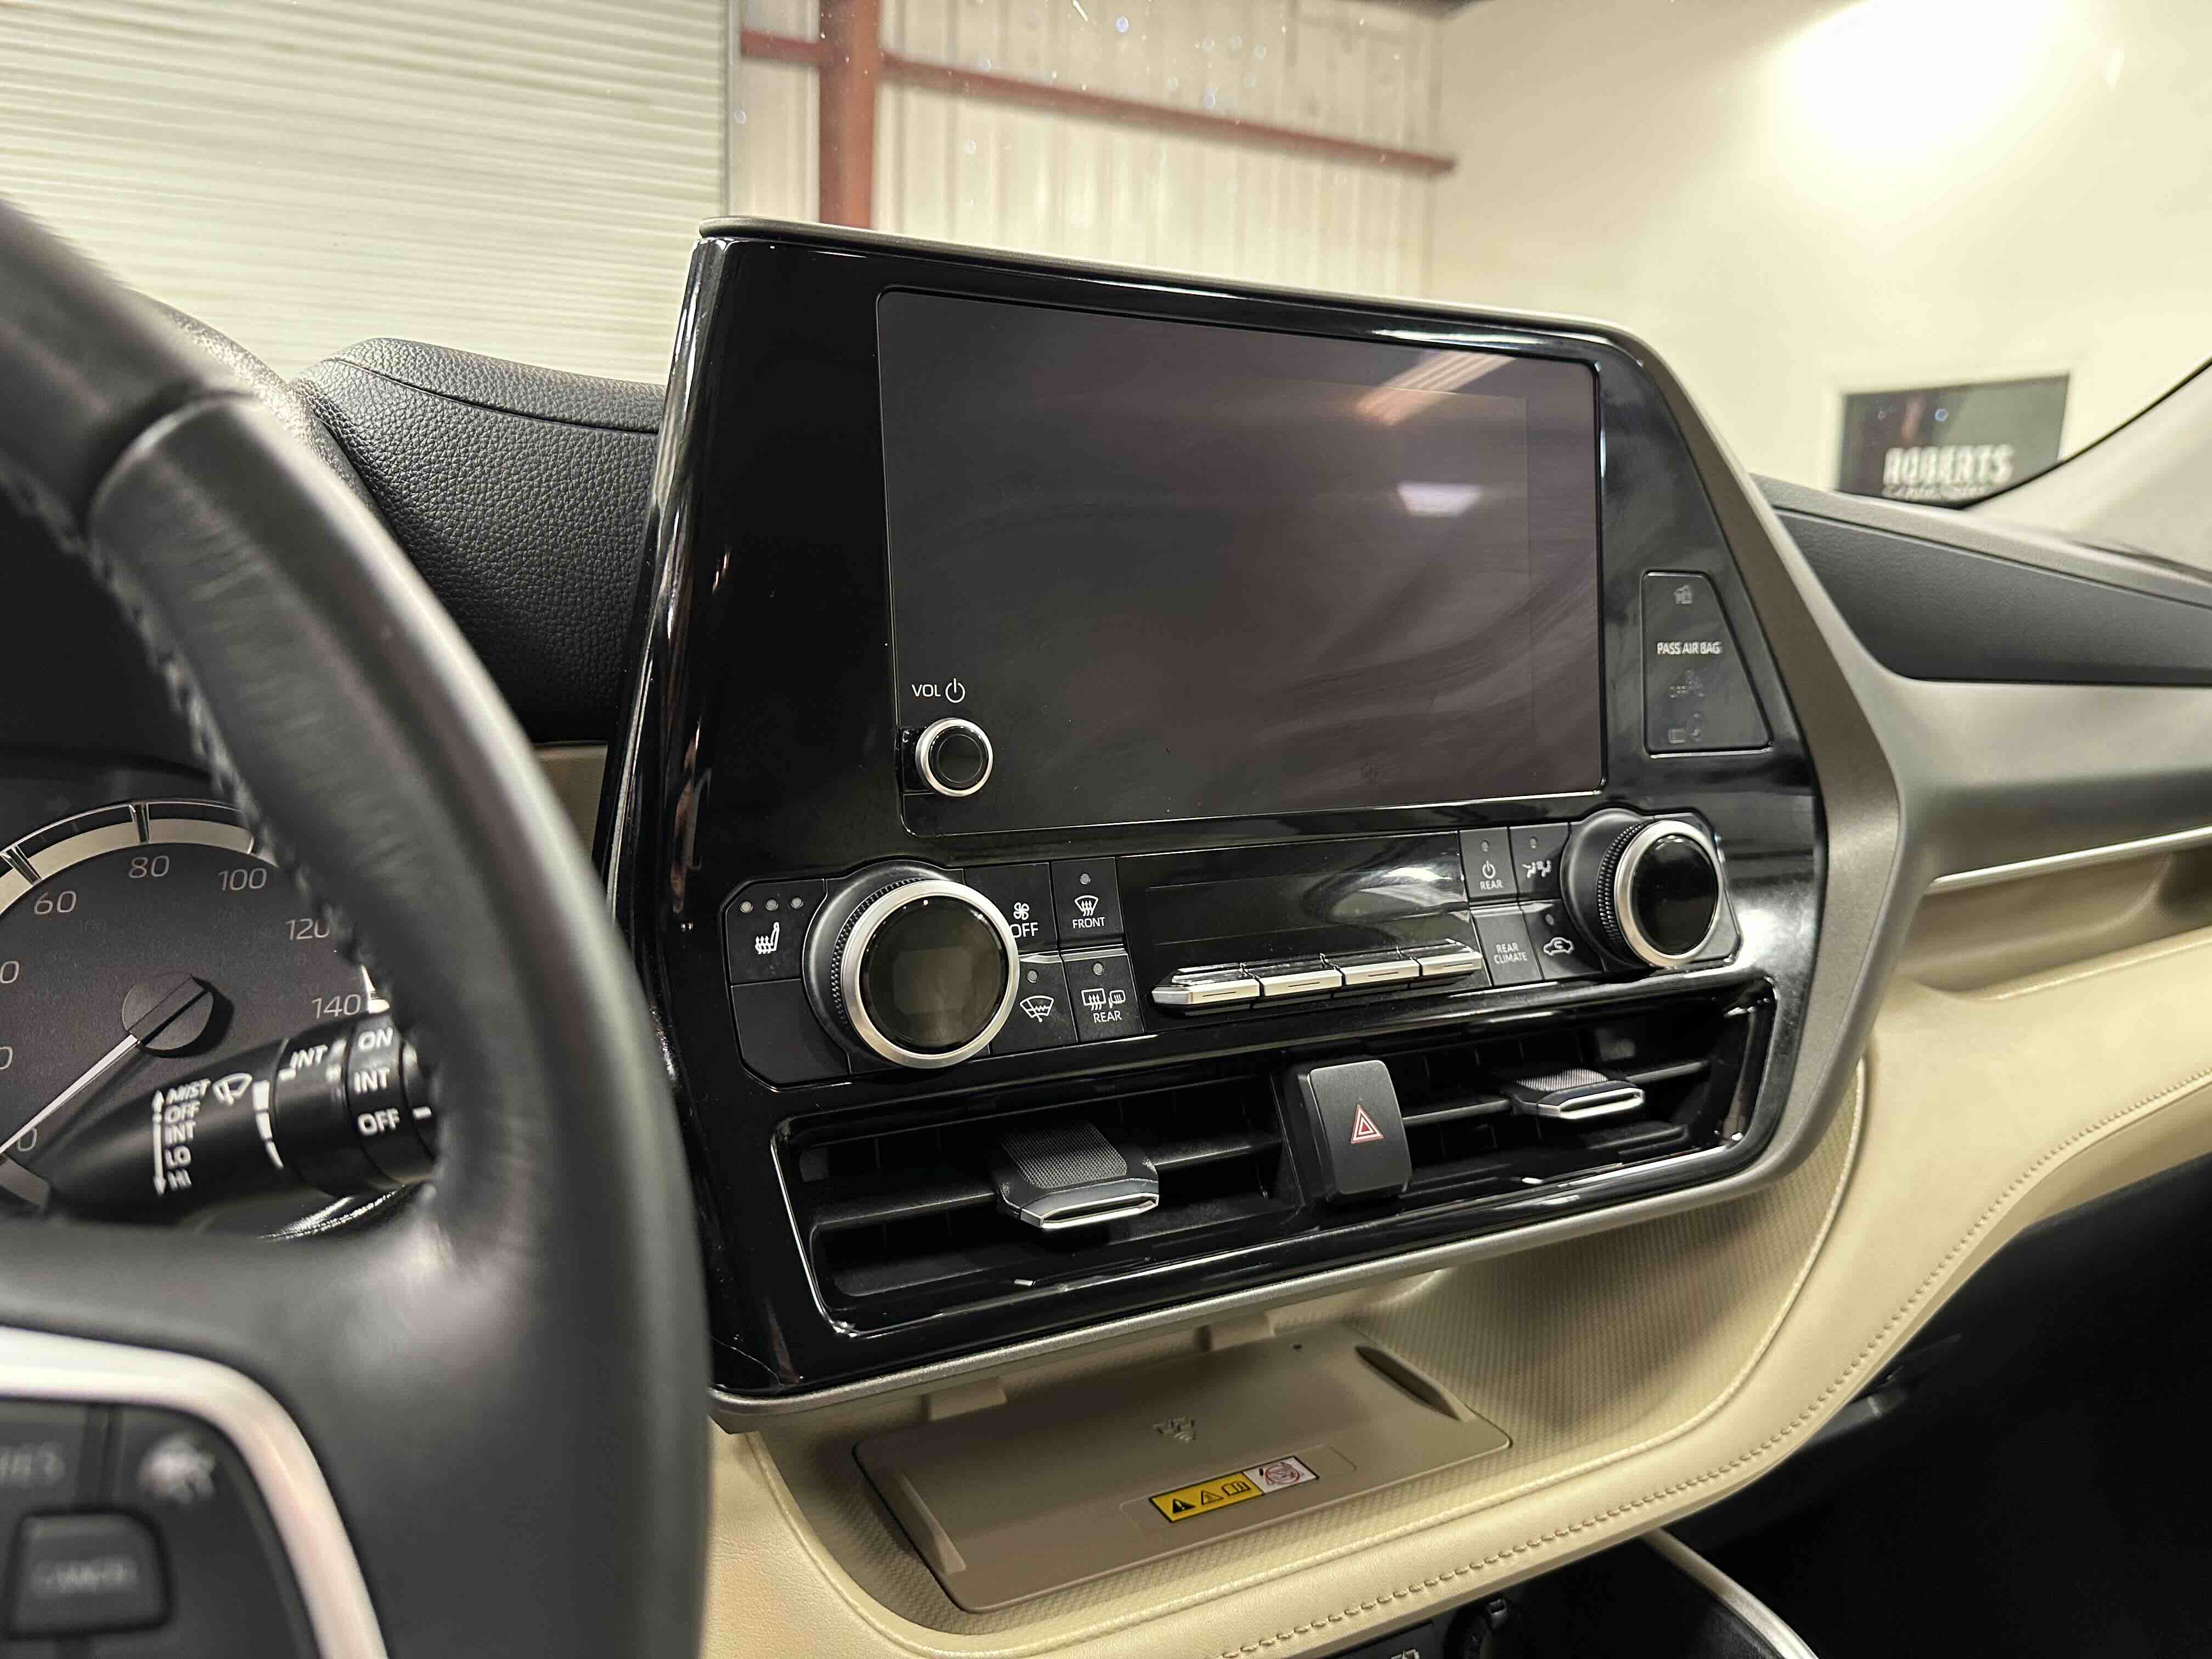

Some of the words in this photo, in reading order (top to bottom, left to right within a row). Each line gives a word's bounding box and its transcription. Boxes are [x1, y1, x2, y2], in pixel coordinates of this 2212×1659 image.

[1882, 444, 2015, 486] ROBERTS
[1656, 641, 1681, 654] PASS
[1682, 641, 1700, 654] AIR
[1700, 641, 1722, 654] BAG
[911, 684, 941, 697] VOL
[128, 855, 170, 878] 80
[217, 867, 268, 891] 100
[1480, 879, 1503, 890] REAR
[34, 890, 78, 915] 60
[1009, 922, 1039, 938] OFF
[1072, 916, 1105, 929] FRONT
[1494, 952, 1528, 964] CLIMATE
[1496, 943, 1519, 952] REAR
[0, 961, 20, 984] 0
[311, 994, 361, 1019] 140
[1093, 1009, 1123, 1023] REAR
[358, 1028, 394, 1051] ON
[290, 1044, 329, 1069] INT
[354, 1066, 391, 1094] INT
[165, 1079, 212, 1105] MIST
[165, 1102, 201, 1123] OFF
[358, 1108, 400, 1136] OFF
[165, 1121, 198, 1145] INT
[165, 1145, 191, 1167] LO
[167, 1168, 193, 1191] HI
